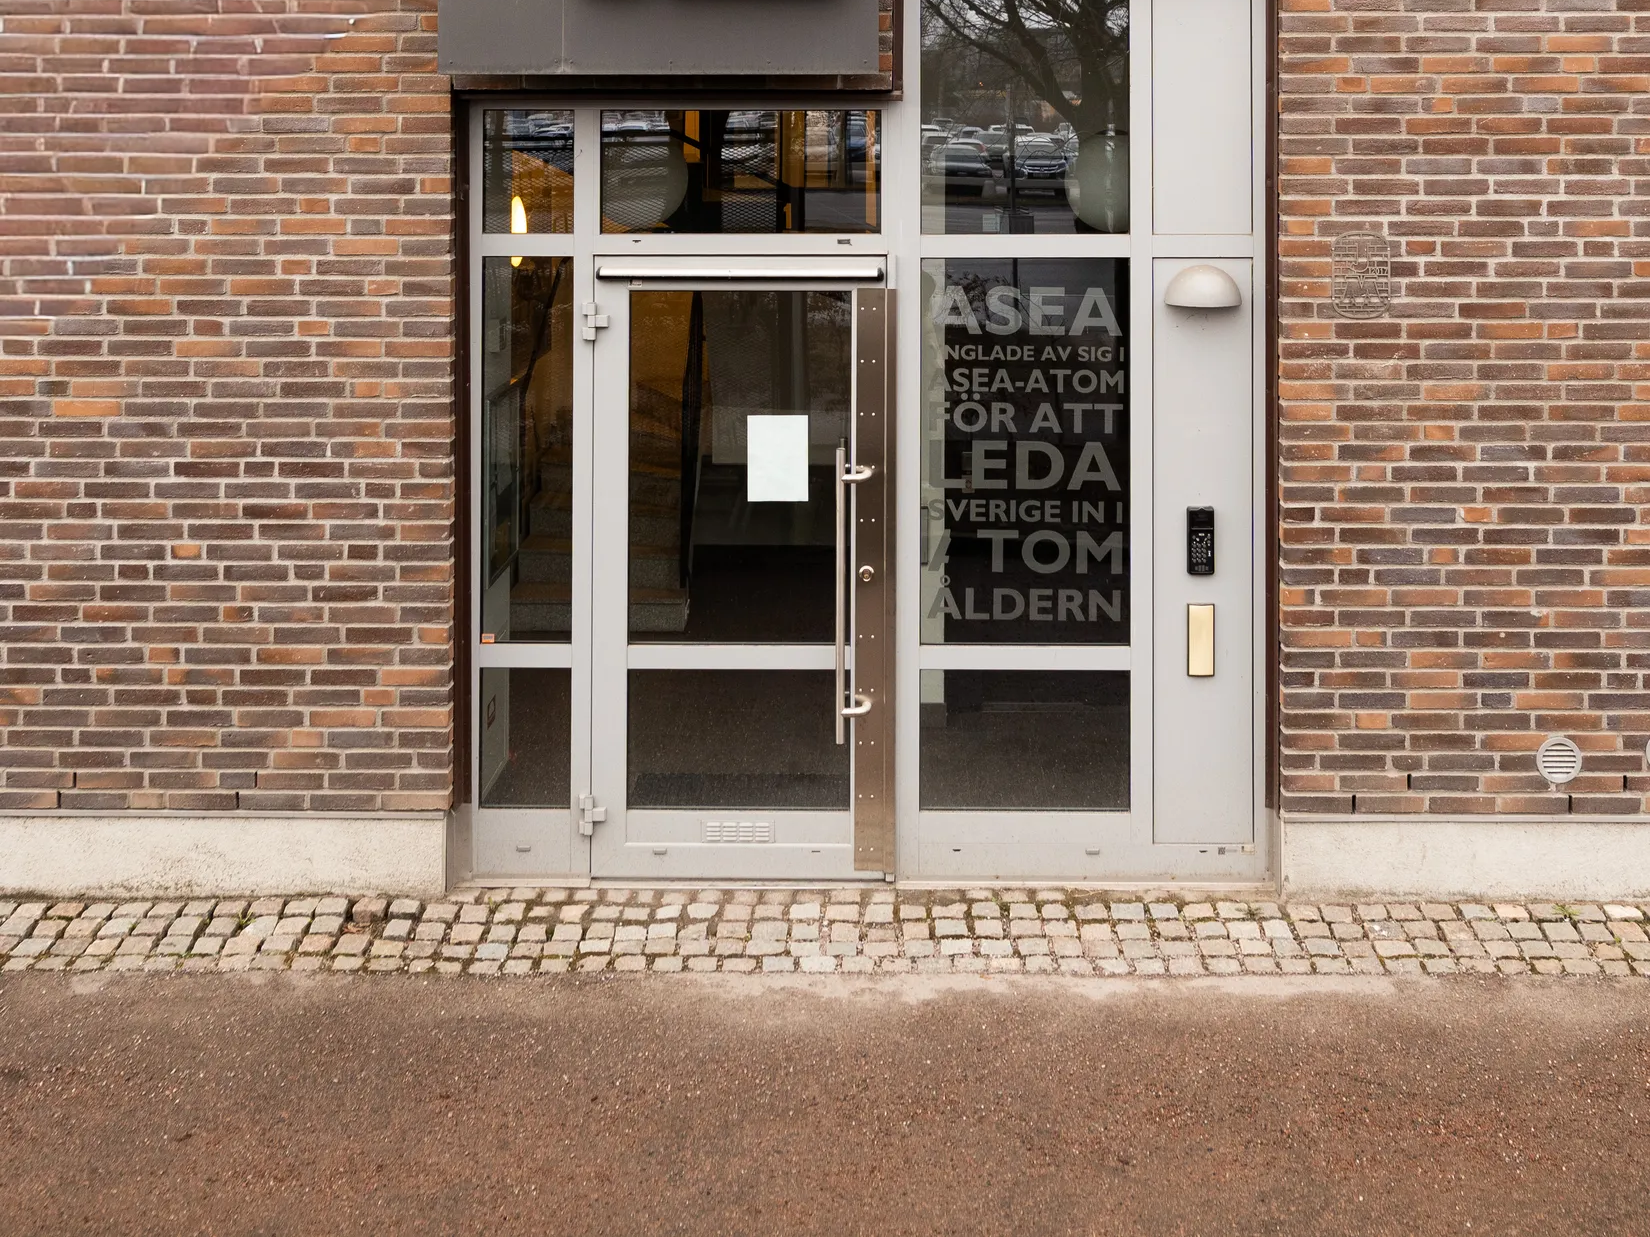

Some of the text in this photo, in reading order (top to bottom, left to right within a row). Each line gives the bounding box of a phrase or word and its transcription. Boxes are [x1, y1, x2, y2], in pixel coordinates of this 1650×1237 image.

[931, 285, 1123, 337] ASEA
[929, 344, 1125, 362] NGLADE AV SIG I
[928, 367, 1125, 394] ASEA-ATOM
[928, 392, 1124, 434] FÖR ATT
[928, 439, 1122, 491] LEDA
[928, 498, 1124, 524] SVERIGE IN I
[927, 574, 1121, 622] ÅLDERN
